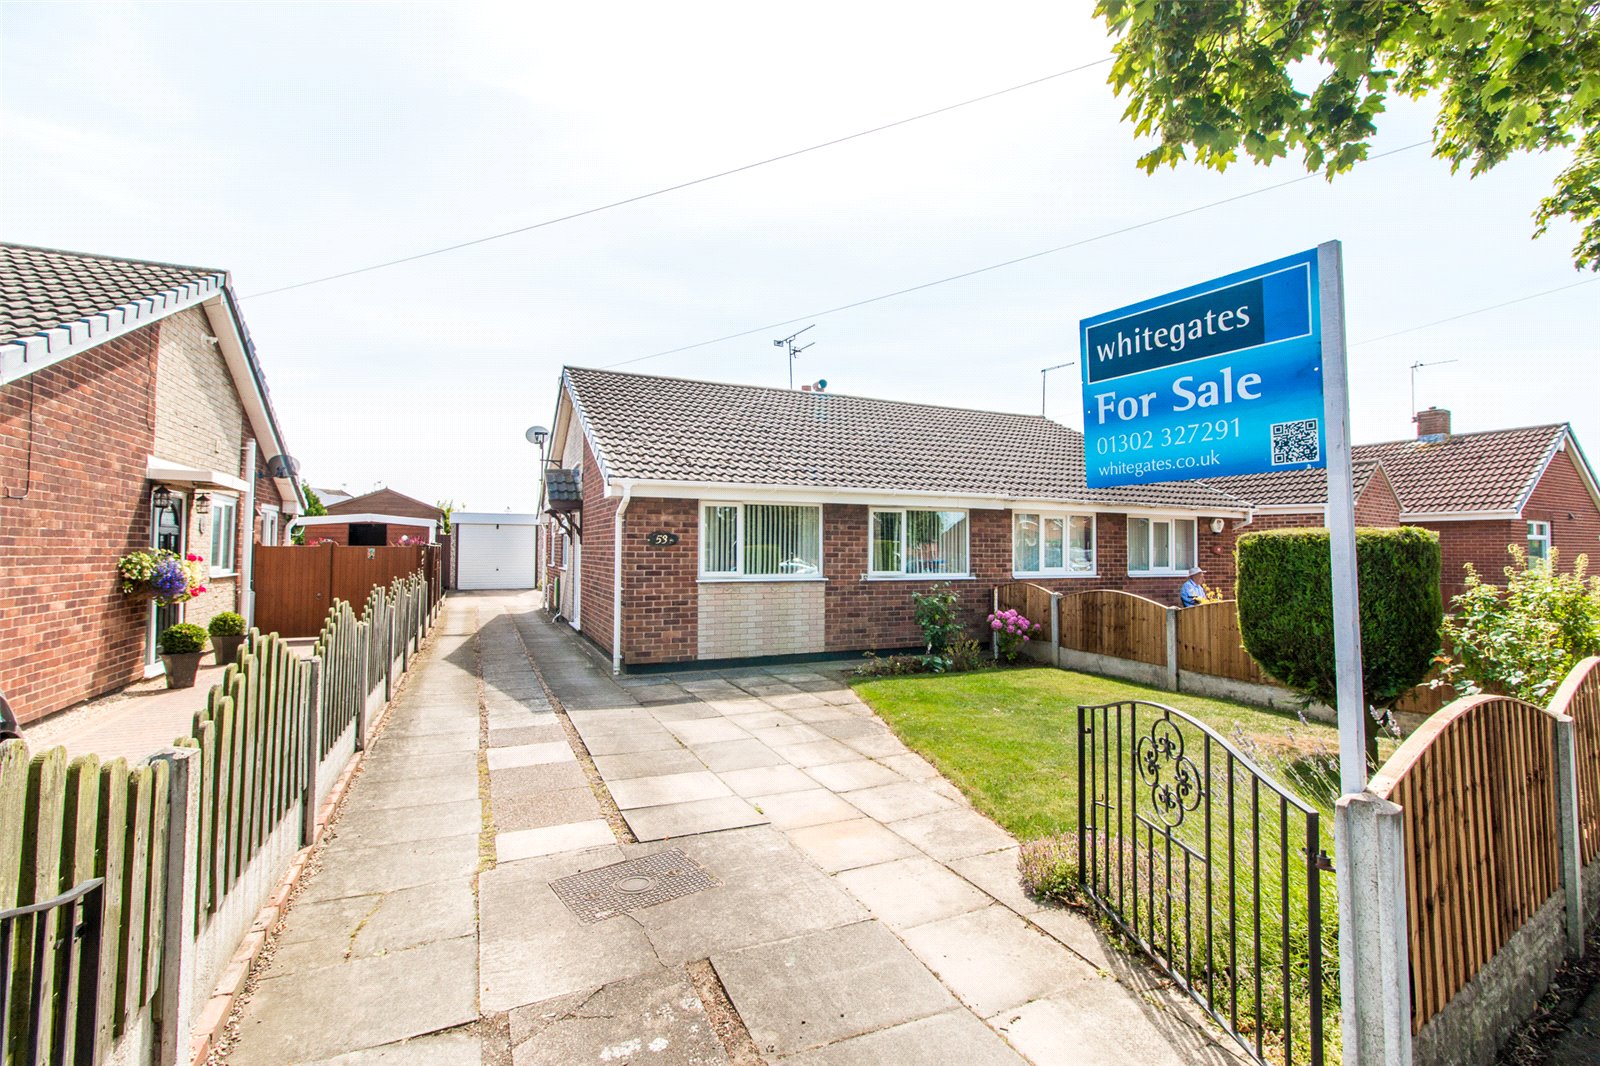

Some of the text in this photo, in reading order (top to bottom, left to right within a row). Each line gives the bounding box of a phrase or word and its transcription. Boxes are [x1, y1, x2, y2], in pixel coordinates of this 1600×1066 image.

[1096, 305, 1251, 363] whitegates
[1094, 366, 1262, 425] For Sale
[1097, 417, 1240, 455] 01302 327291
[1098, 449, 1221, 478] whitegates.co.uk
[655, 534, 668, 545] 59
